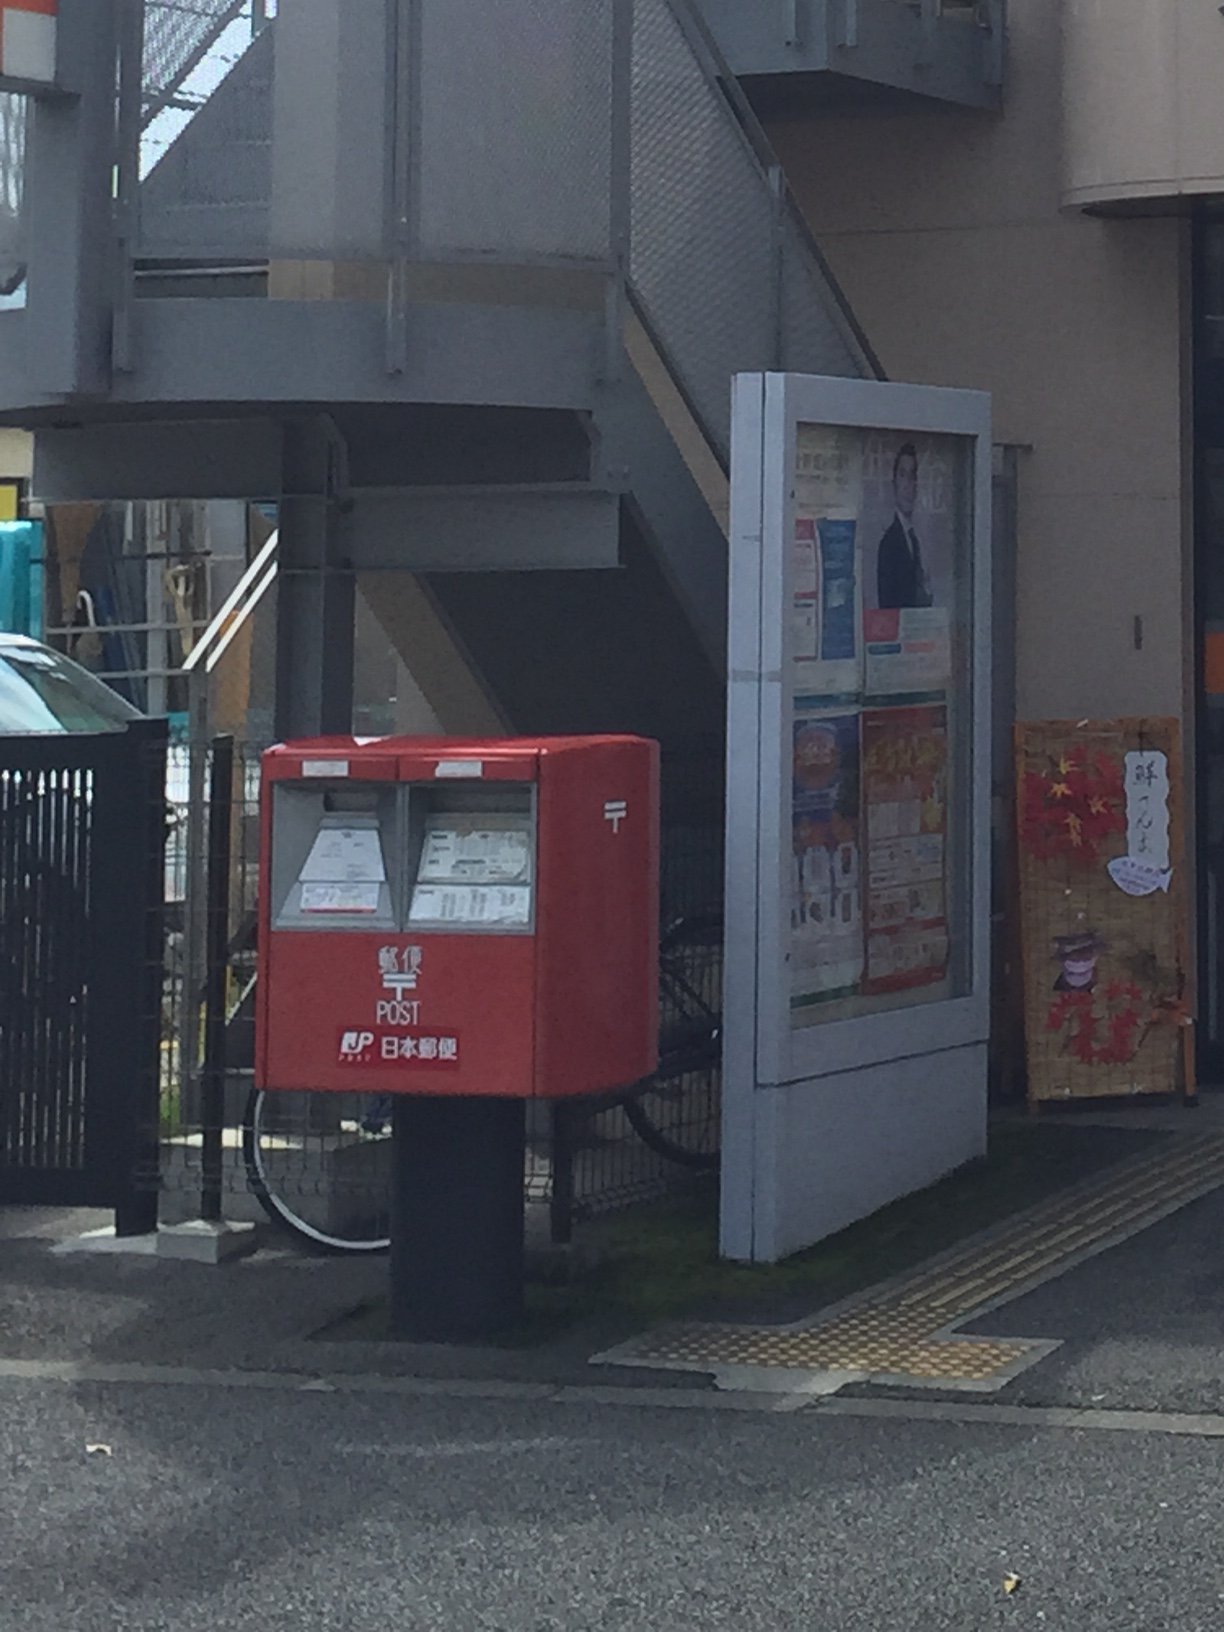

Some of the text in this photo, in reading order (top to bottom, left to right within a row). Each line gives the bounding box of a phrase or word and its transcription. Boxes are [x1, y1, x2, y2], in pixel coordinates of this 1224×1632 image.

[376, 1000, 422, 1025] POST
[381, 1035, 458, 1061] 日本郵便
